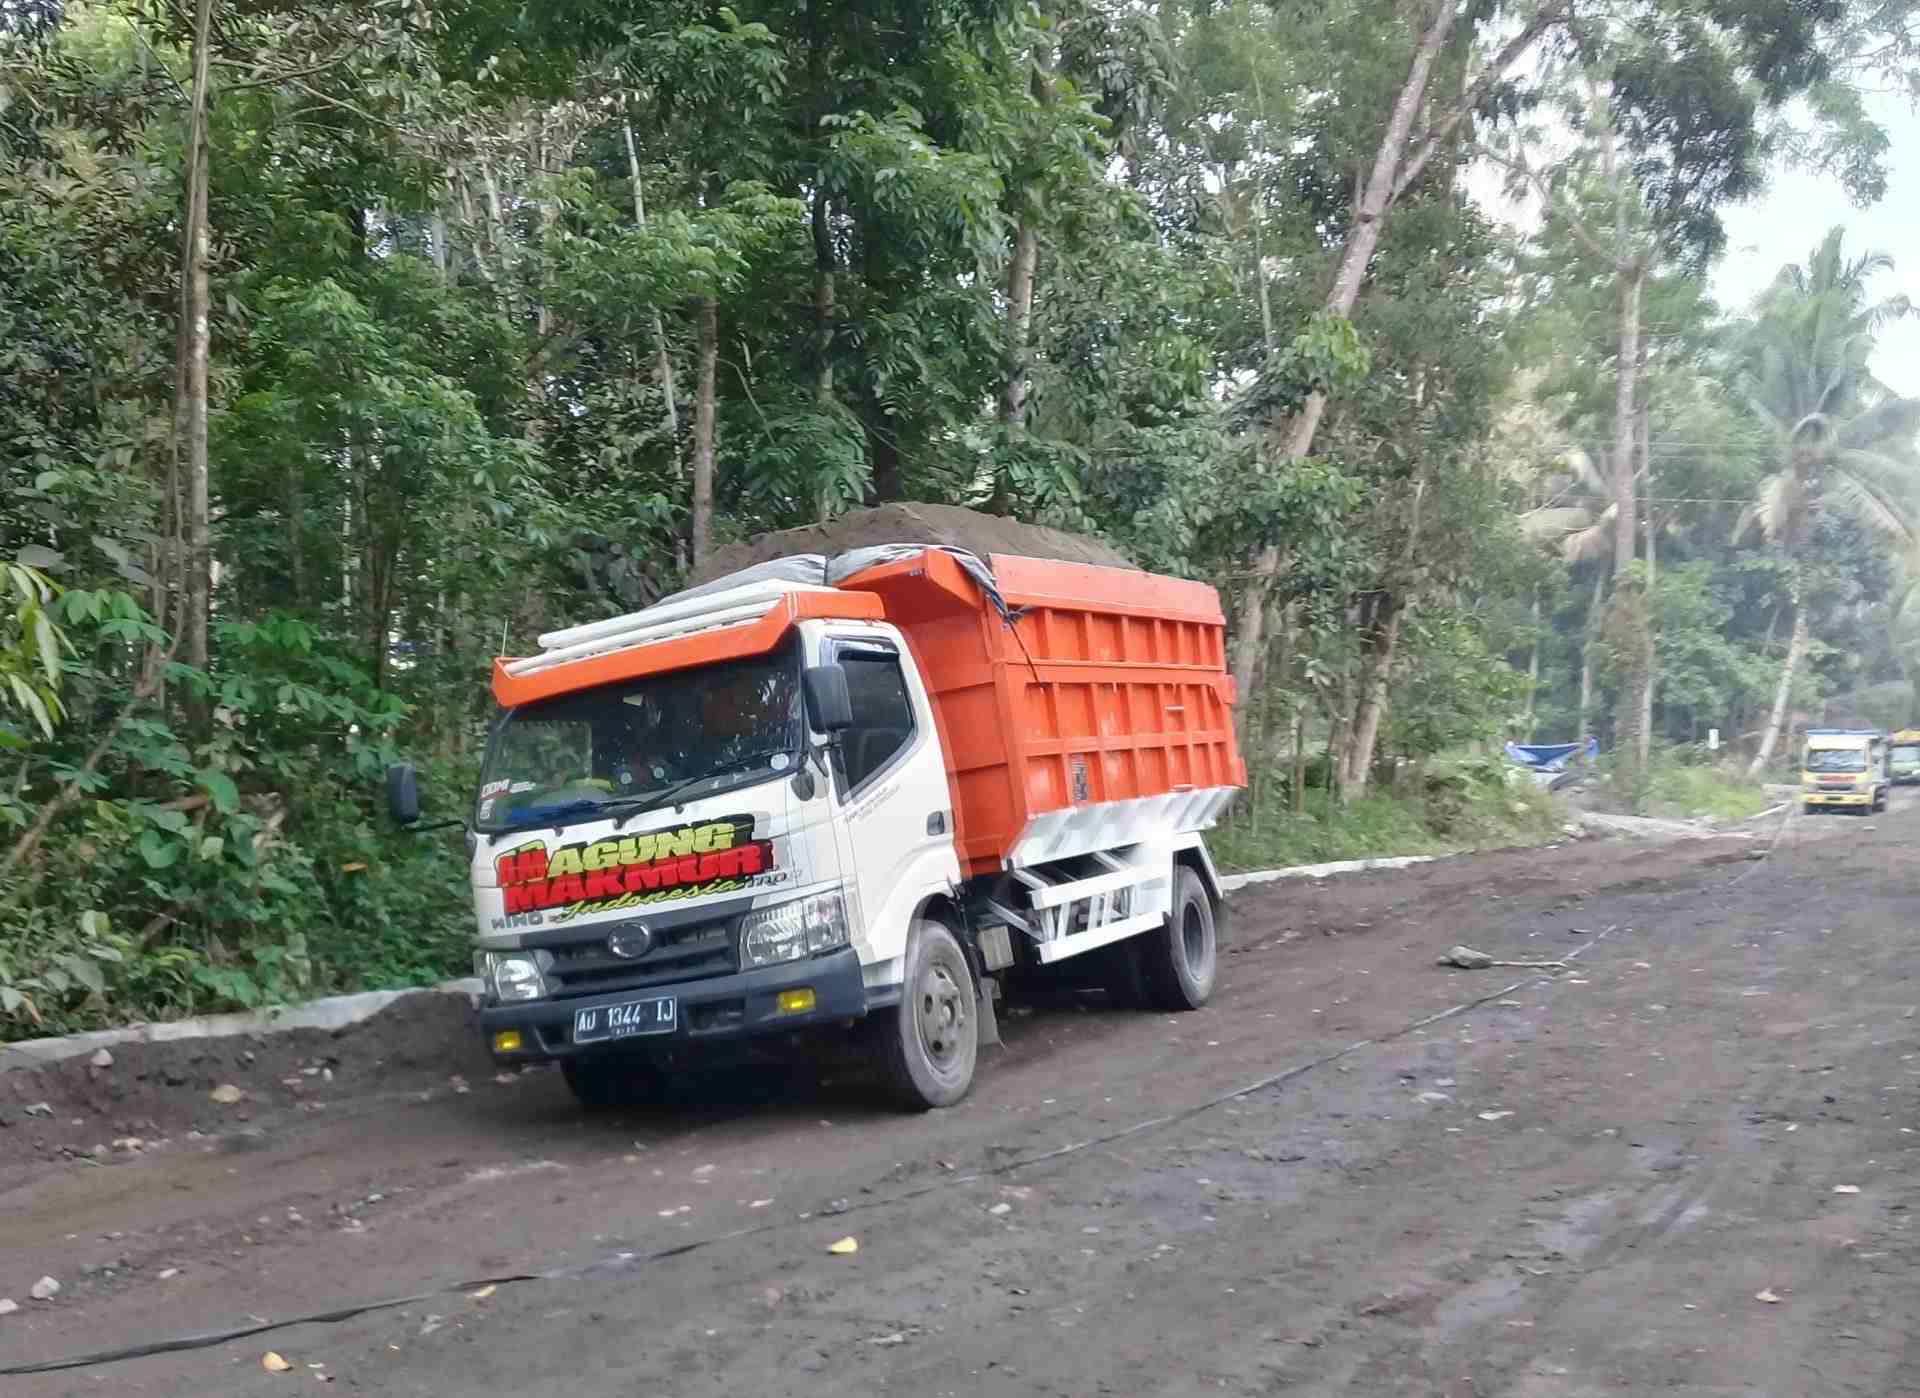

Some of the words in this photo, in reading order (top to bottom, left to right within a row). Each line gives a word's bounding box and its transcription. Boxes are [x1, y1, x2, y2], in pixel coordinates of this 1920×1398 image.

[546, 823, 736, 878] AGUNG
[503, 843, 764, 914] MAKMUR
[490, 911, 544, 929] HINO
